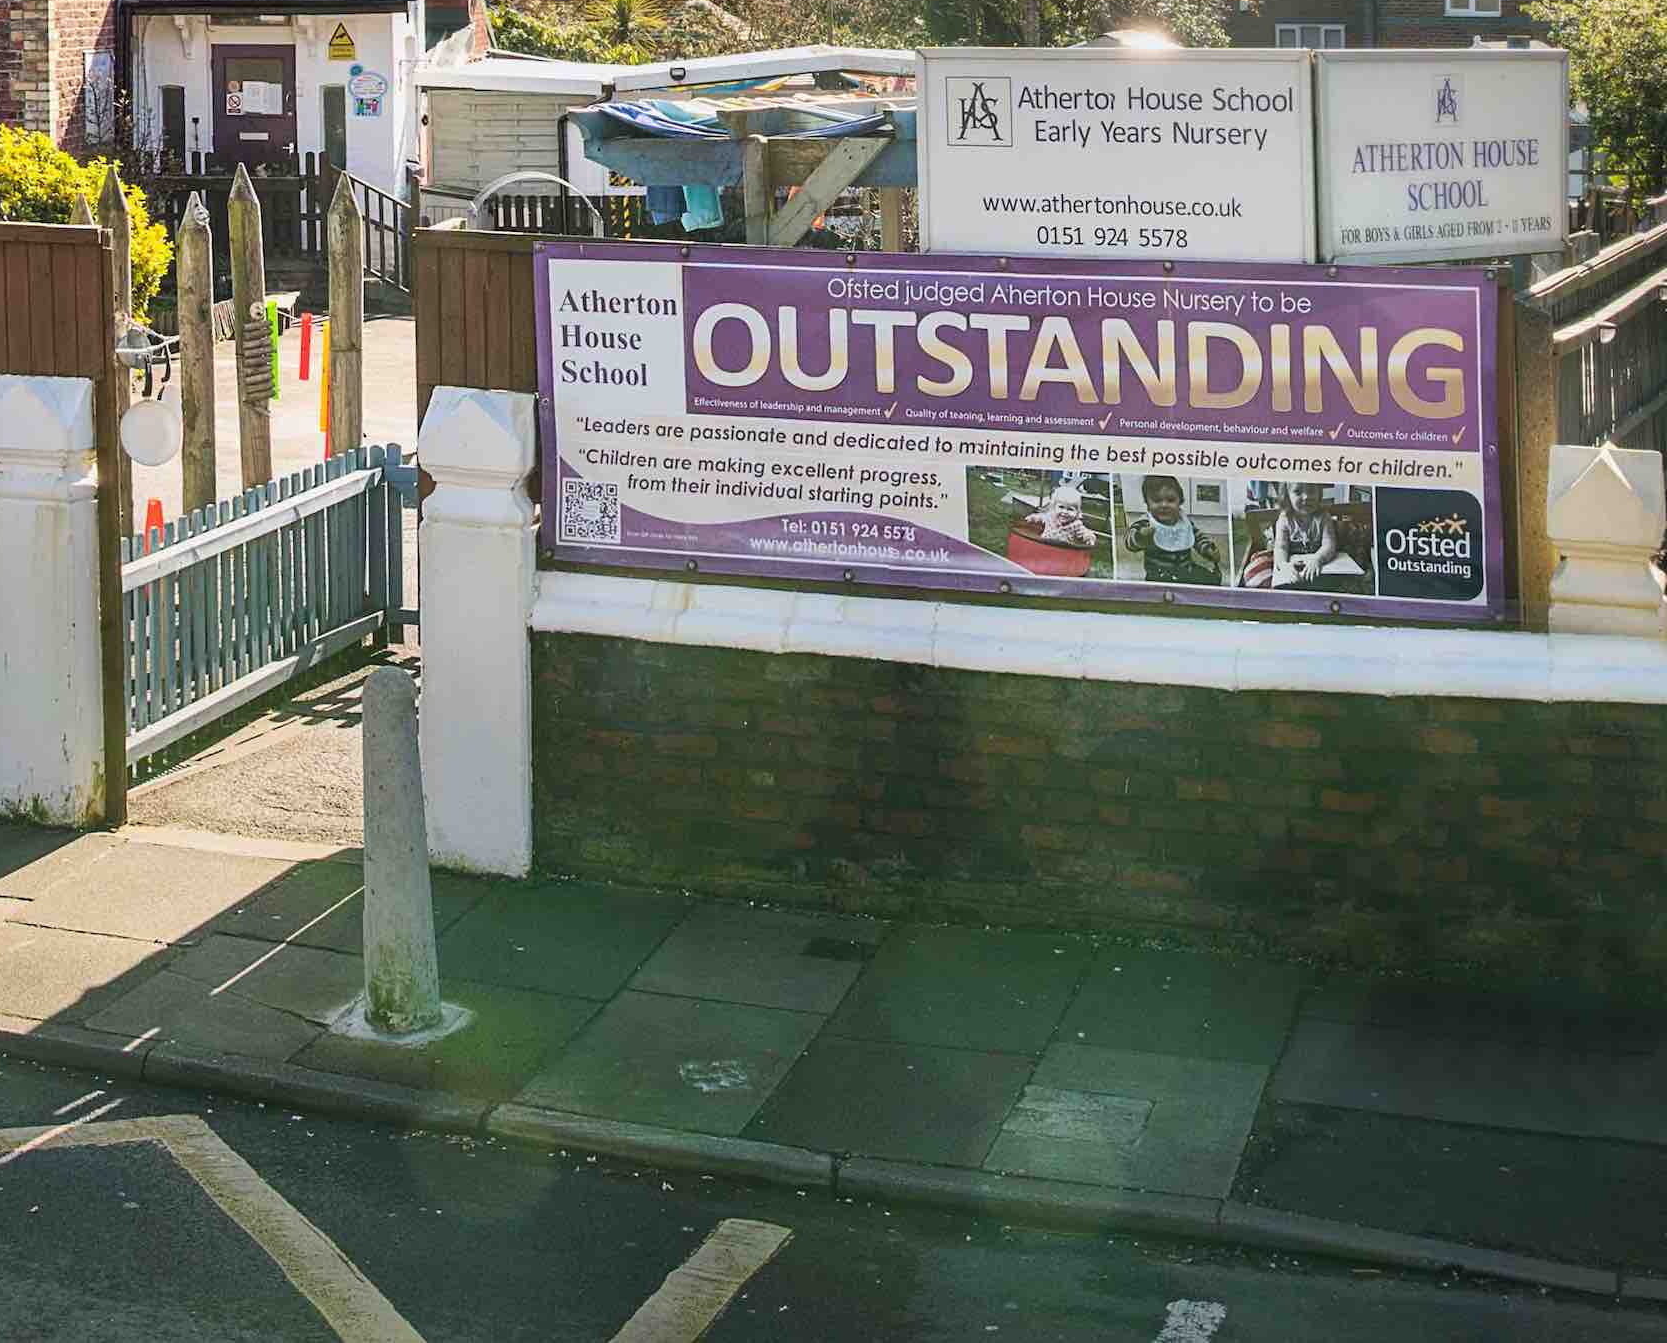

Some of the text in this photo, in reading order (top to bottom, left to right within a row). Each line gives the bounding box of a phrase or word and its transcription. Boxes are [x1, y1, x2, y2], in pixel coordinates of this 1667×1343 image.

[1127, 87, 1202, 112] House
[1212, 87, 1293, 113] School
[1034, 120, 1267, 151] Early Years Nursery
[1352, 138, 1540, 174] ATHERTON HOUSE
[982, 193, 1243, 218] www.athertonhouse.co.uk
[1407, 179, 1489, 212] SCHOOL
[1037, 226, 1188, 249] 0151 924 5578
[1341, 228, 1361, 245] FOR
[1365, 226, 1391, 244] BOYS
[1403, 224, 1435, 241] GIRLS
[1435, 222, 1465, 240] AGED
[1466, 220, 1494, 238] FROM
[1520, 216, 1552, 234] YEARS
[559, 288, 677, 316] Atherton
[827, 277, 899, 300] Ofsted
[903, 279, 985, 307] judged
[1088, 286, 1157, 309] House
[1163, 288, 1246, 317] Nursery
[1251, 291, 1273, 313] to
[1281, 292, 1312, 314] be
[560, 323, 642, 350] House
[560, 358, 649, 388] School
[692, 302, 1466, 419] OUTSTANDING
[694, 396, 882, 418] Effectiveness of leadership and management
[905, 408, 937, 421] Quality
[938, 410, 949, 419] of
[987, 412, 1024, 426] learning
[1025, 414, 1042, 425] and
[1044, 416, 1095, 427] assessment
[1119, 418, 1325, 437] Personal development, behaviour and welfare
[1347, 427, 1449, 443] Outcomes for children
[576, 416, 650, 436] “Leaders
[655, 423, 684, 438] are
[689, 425, 786, 444] passionate
[793, 430, 827, 447] and
[833, 432, 931, 453] dedicated
[935, 436, 953, 454] to
[1070, 443, 1100, 462] the
[1107, 444, 1147, 464] best
[1152, 448, 1229, 468] possible
[1235, 455, 1332, 473] outcomes
[1338, 456, 1364, 475] for
[579, 448, 942, 488] “Children are making excellent progress,
[628, 474, 666, 493] from
[672, 477, 711, 494] their
[716, 480, 803, 500] individual
[808, 485, 873, 508] starting
[781, 518, 808, 534] Tel:
[810, 521, 846, 536] 0151
[852, 522, 879, 539] 924
[1385, 528, 1471, 559] Ofsted
[1387, 556, 1472, 579] Outstanding
